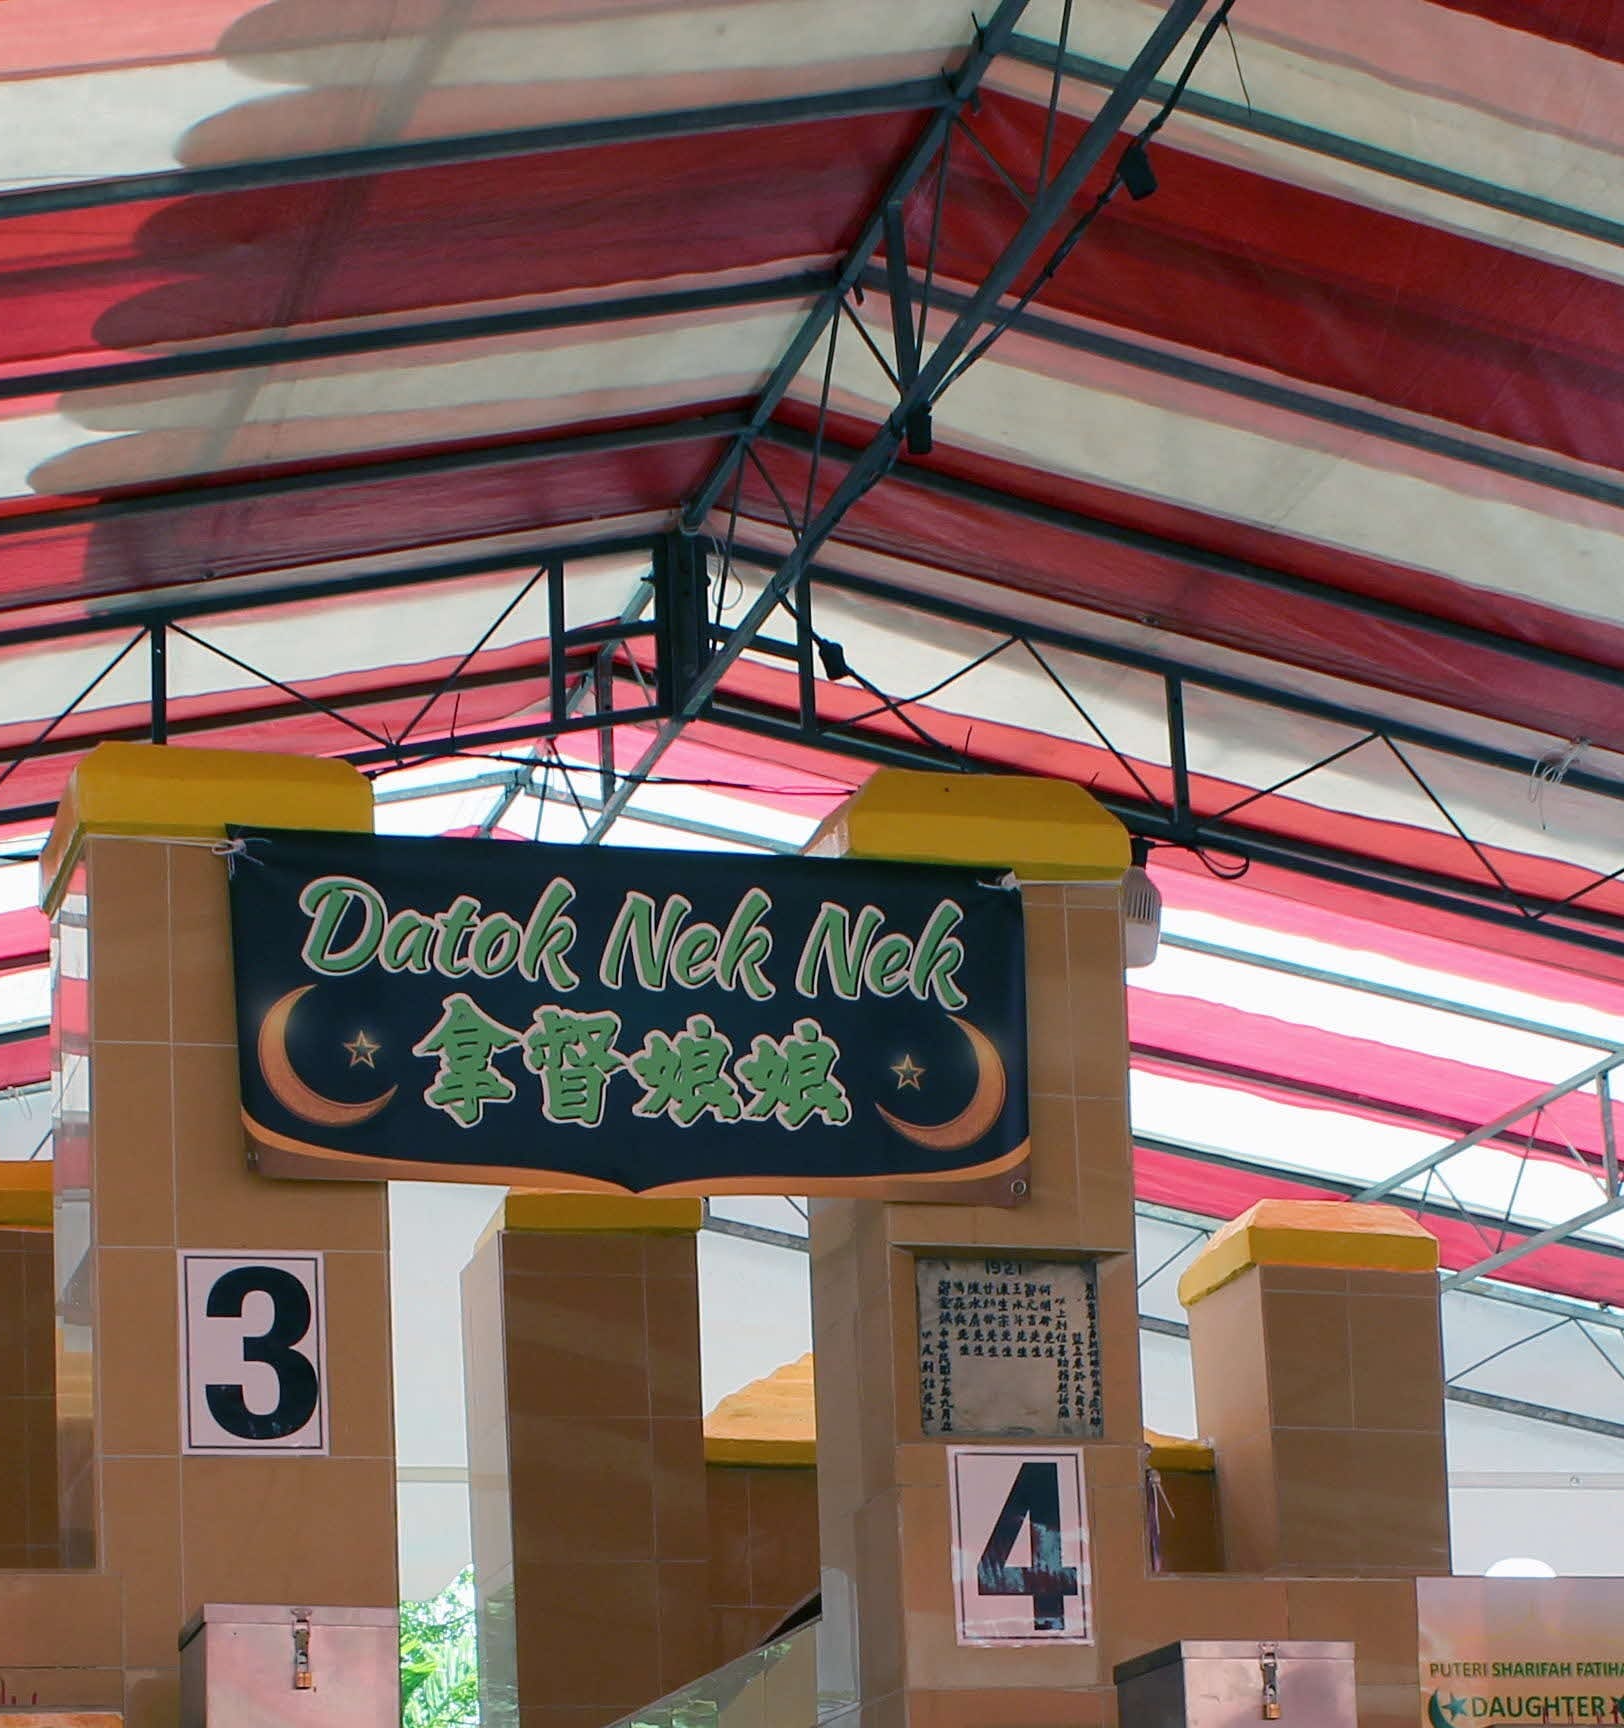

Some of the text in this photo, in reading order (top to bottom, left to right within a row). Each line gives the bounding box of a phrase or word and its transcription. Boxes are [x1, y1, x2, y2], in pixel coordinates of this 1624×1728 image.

[298, 875, 967, 1011] Datok Nek Nek
[413, 993, 853, 1130] 拿督娘娘
[984, 1258, 1023, 1276] 1921
[205, 1265, 319, 1440] 3
[977, 1461, 1078, 1631] 4
[1429, 1661, 1487, 1678] PUTERI
[1491, 1661, 1572, 1677] SHARIFAH
[1471, 1696, 1607, 1718] DAUGHTER
